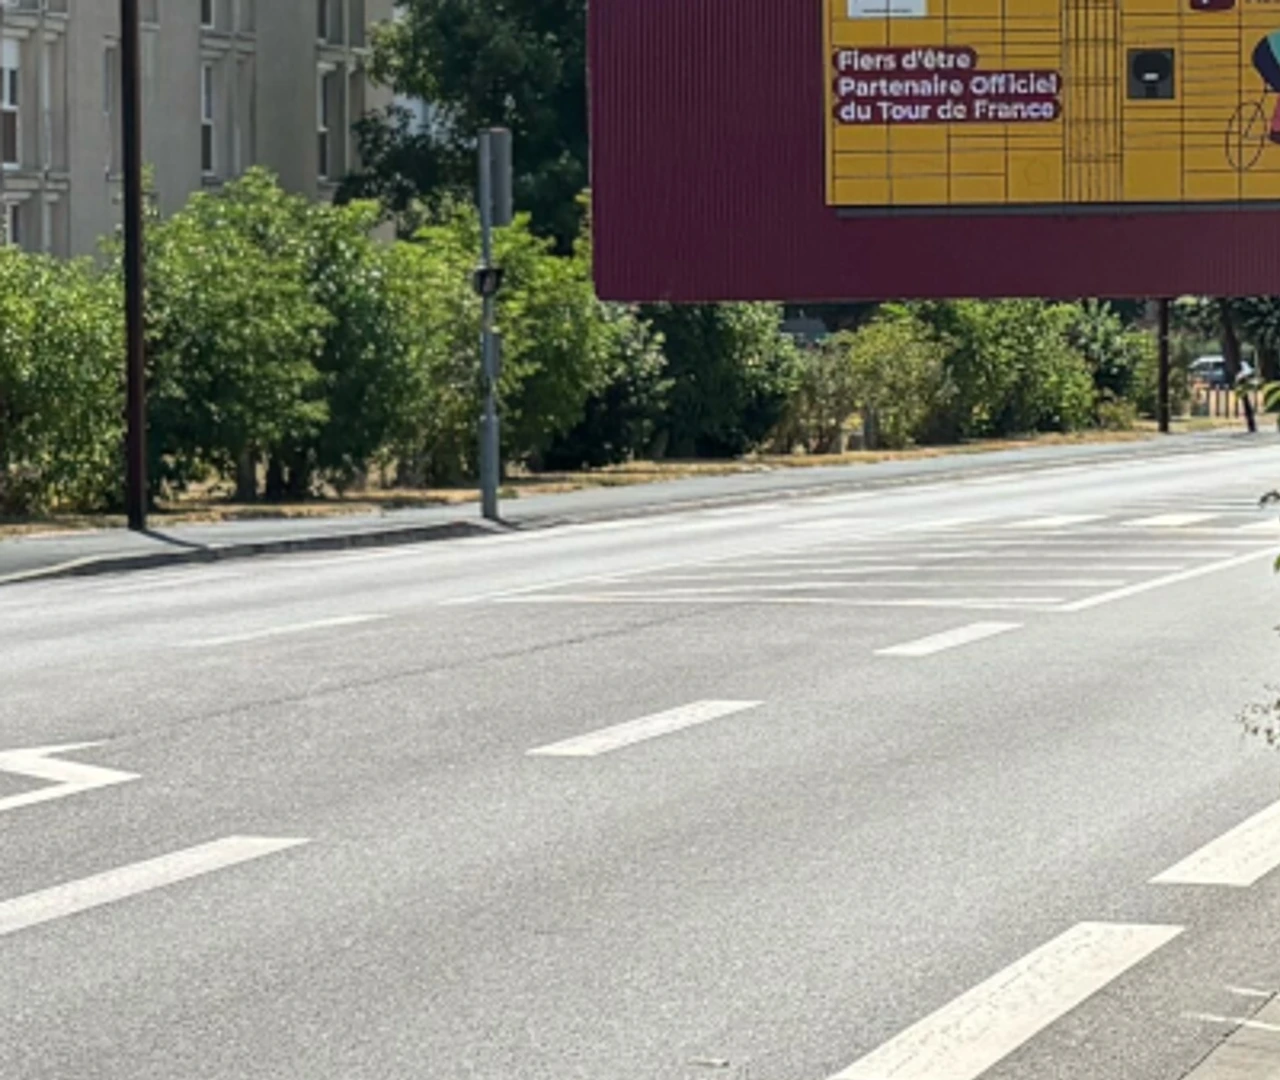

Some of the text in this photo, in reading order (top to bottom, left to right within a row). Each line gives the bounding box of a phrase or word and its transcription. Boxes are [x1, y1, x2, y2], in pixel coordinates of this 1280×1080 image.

[838, 48, 971, 70] Fiers d'être
[838, 73, 1058, 97] Partenaire Officiel
[840, 99, 1054, 120] du Tour de France
